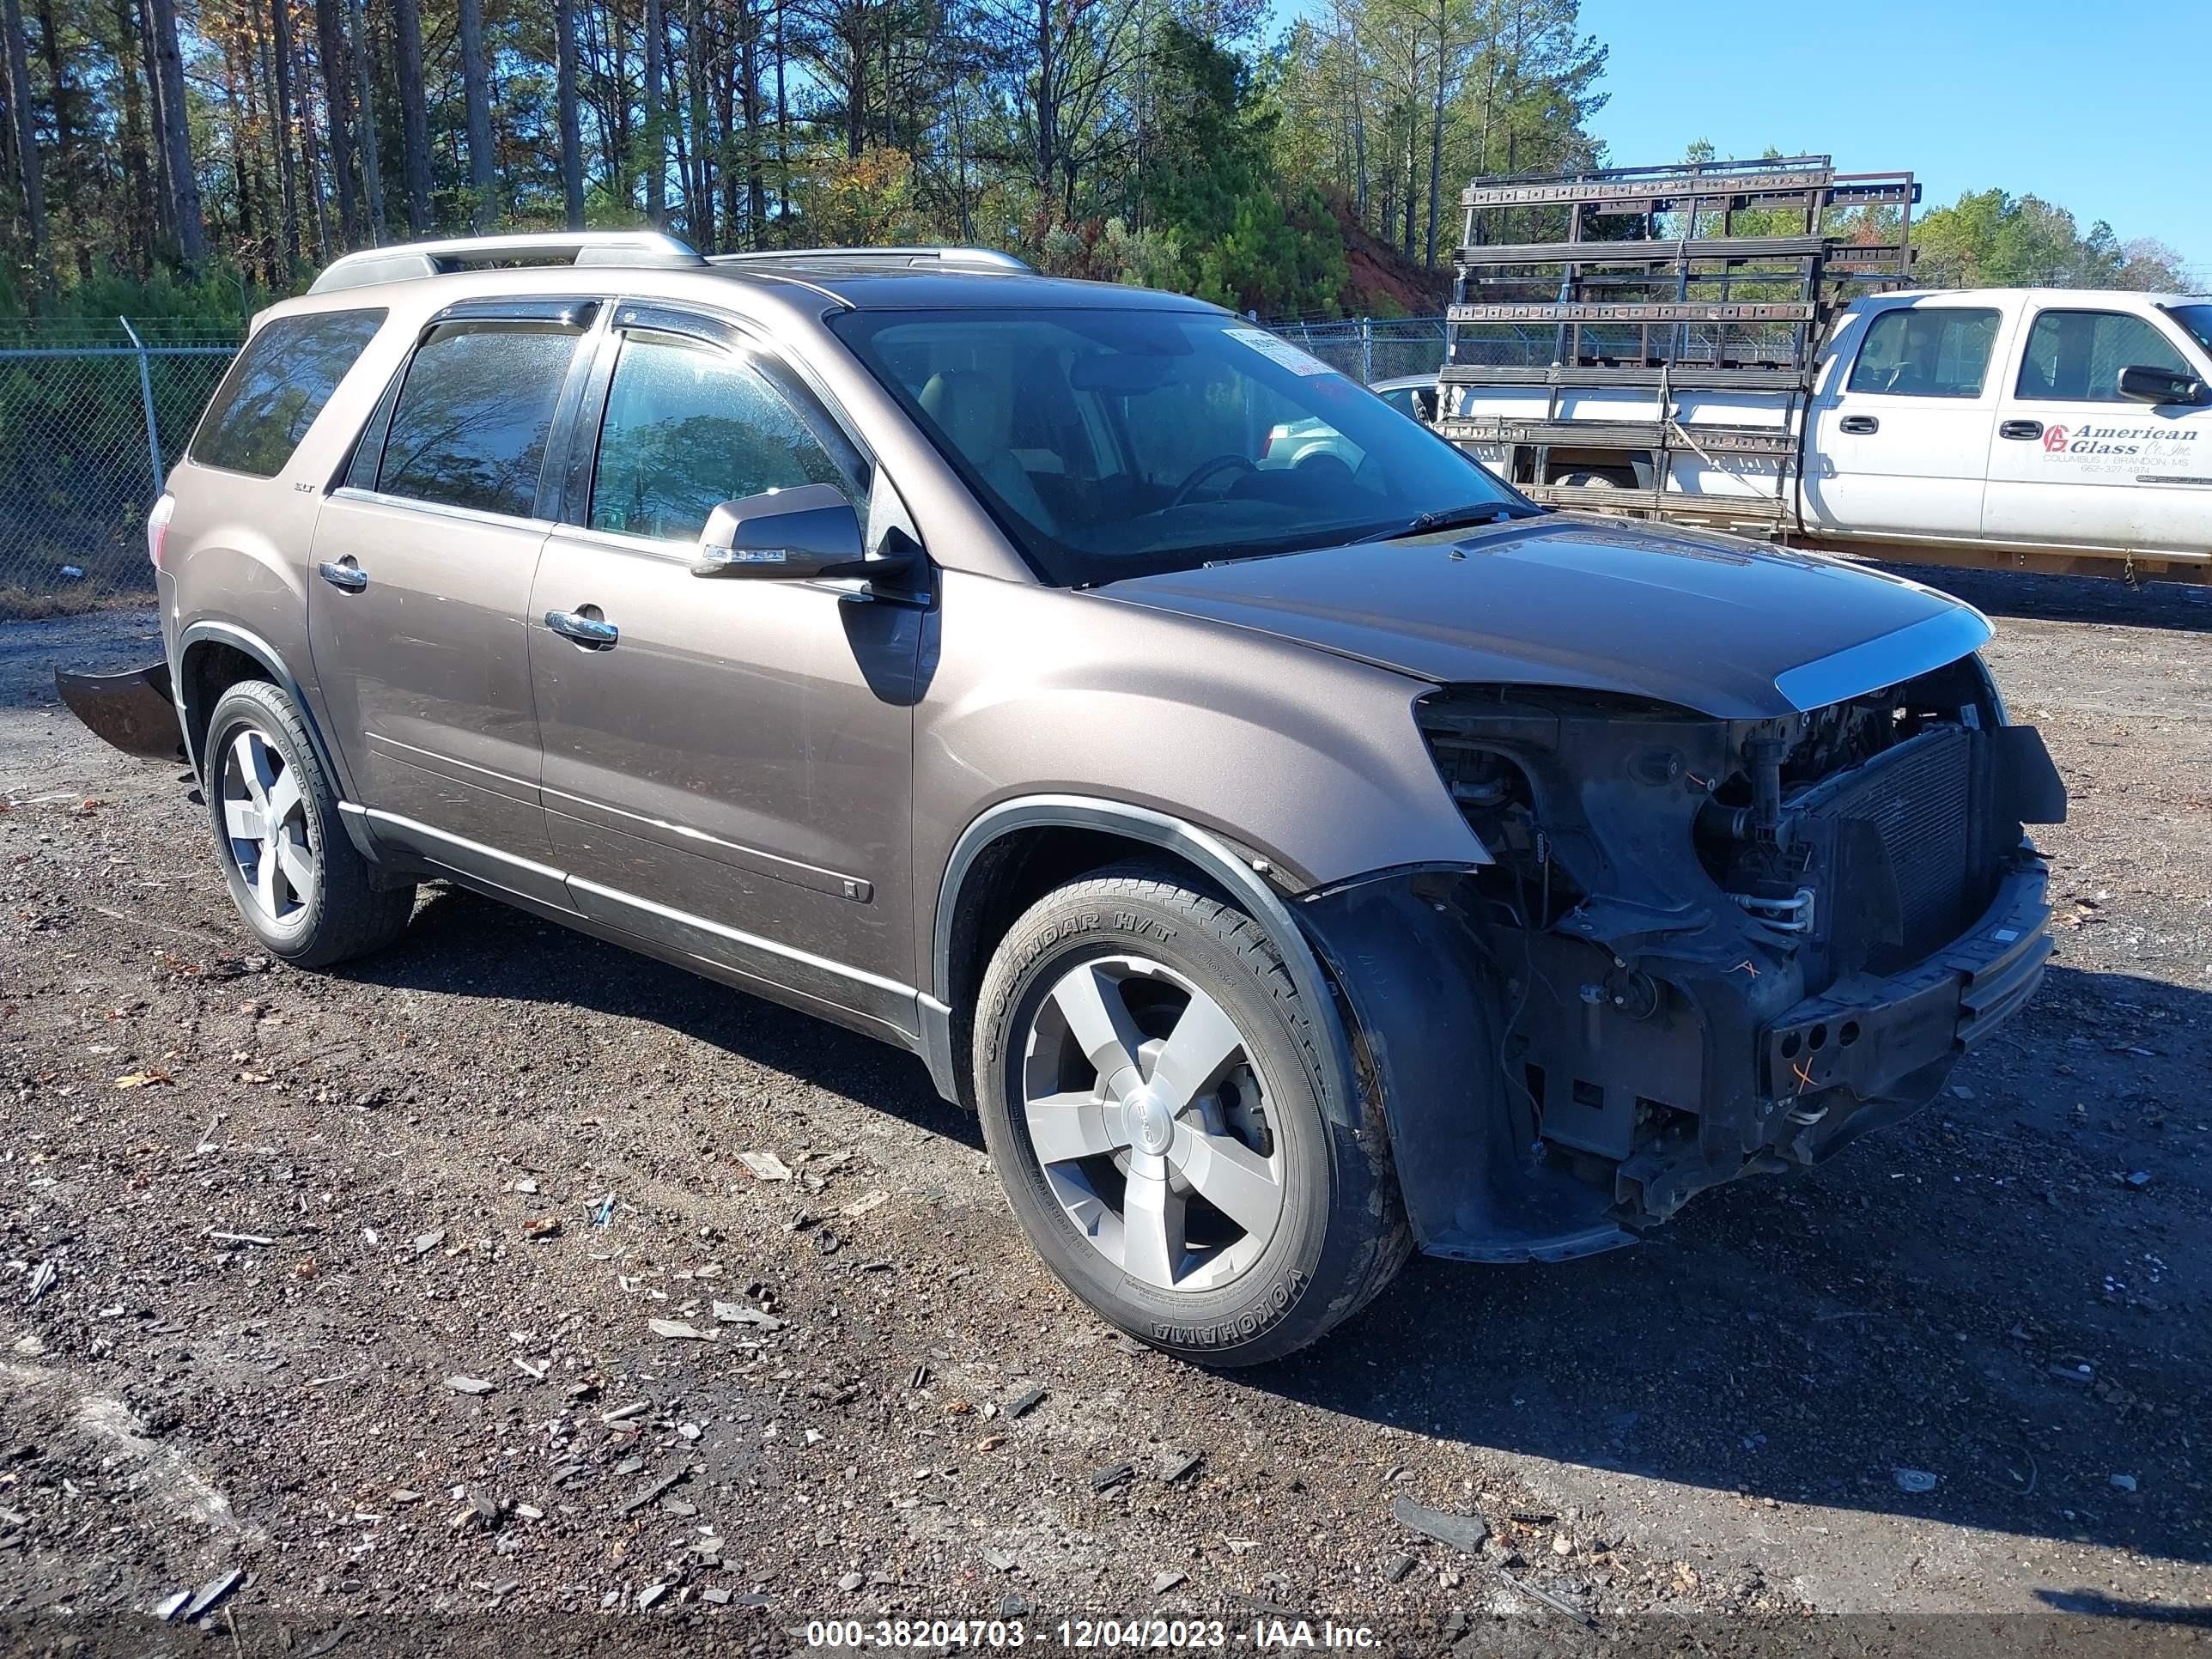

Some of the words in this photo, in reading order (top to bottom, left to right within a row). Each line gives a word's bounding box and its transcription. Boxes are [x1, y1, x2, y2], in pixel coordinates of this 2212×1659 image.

[2072, 425, 2198, 441] American
[2070, 441, 2140, 455] Glass
[2166, 442, 2191, 457] Inc.
[2043, 454, 2100, 464] COLUMBUS
[2172, 459, 2189, 467] MS
[987, 912, 1100, 1062] GEOLANDAR
[1114, 911, 1177, 943] H/T
[1151, 1266, 1304, 1346] YOKOHAMA
